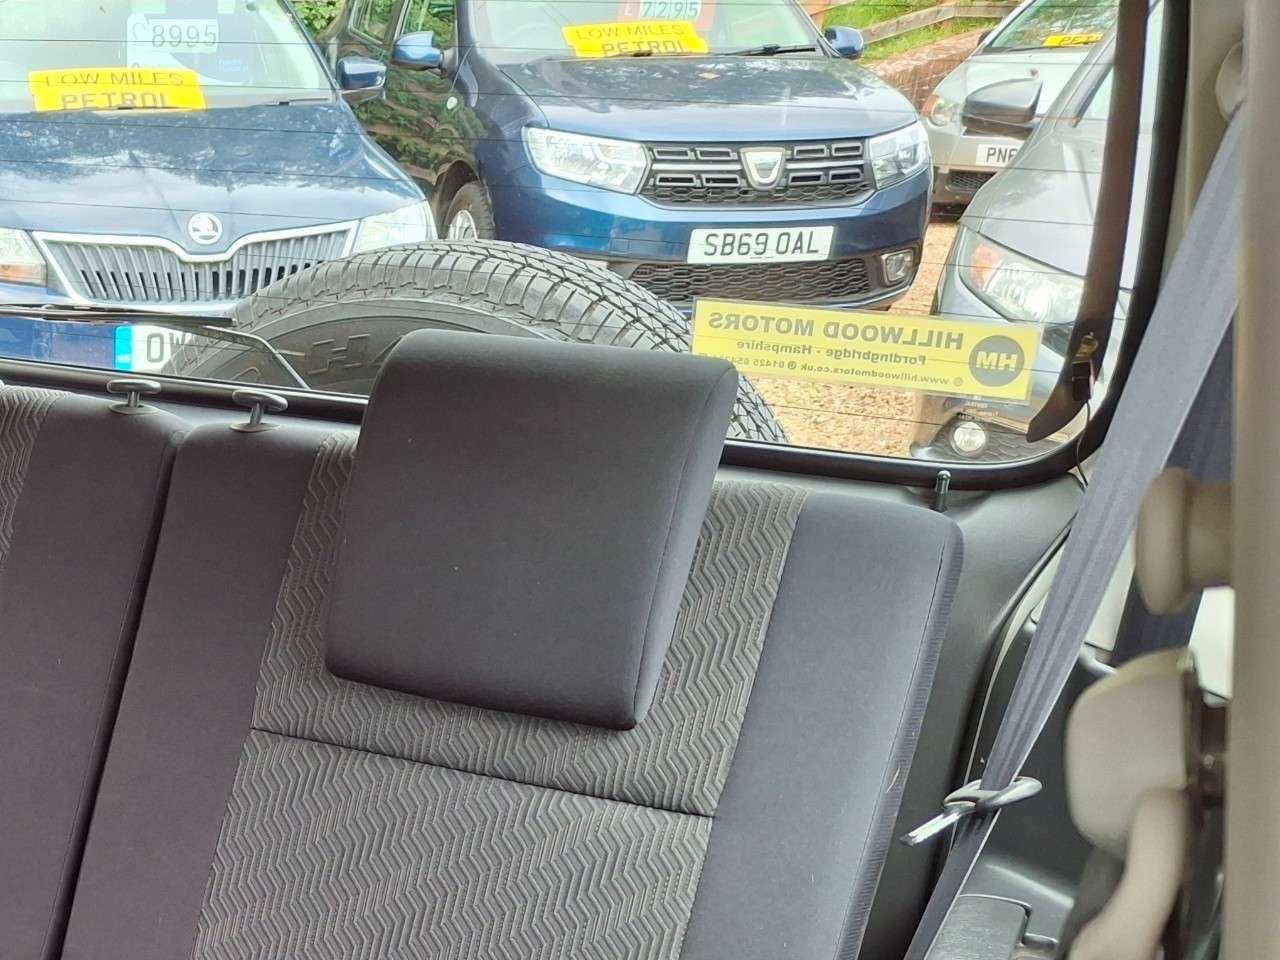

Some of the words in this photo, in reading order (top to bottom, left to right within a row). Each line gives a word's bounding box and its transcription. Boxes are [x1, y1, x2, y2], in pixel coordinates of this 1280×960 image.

[575, 27, 619, 40] LOW
[627, 23, 685, 36] MILES
[45, 73, 100, 88] LOW
[110, 71, 184, 86] MILES
[703, 232, 769, 256] SB69
[775, 231, 820, 255] OAL
